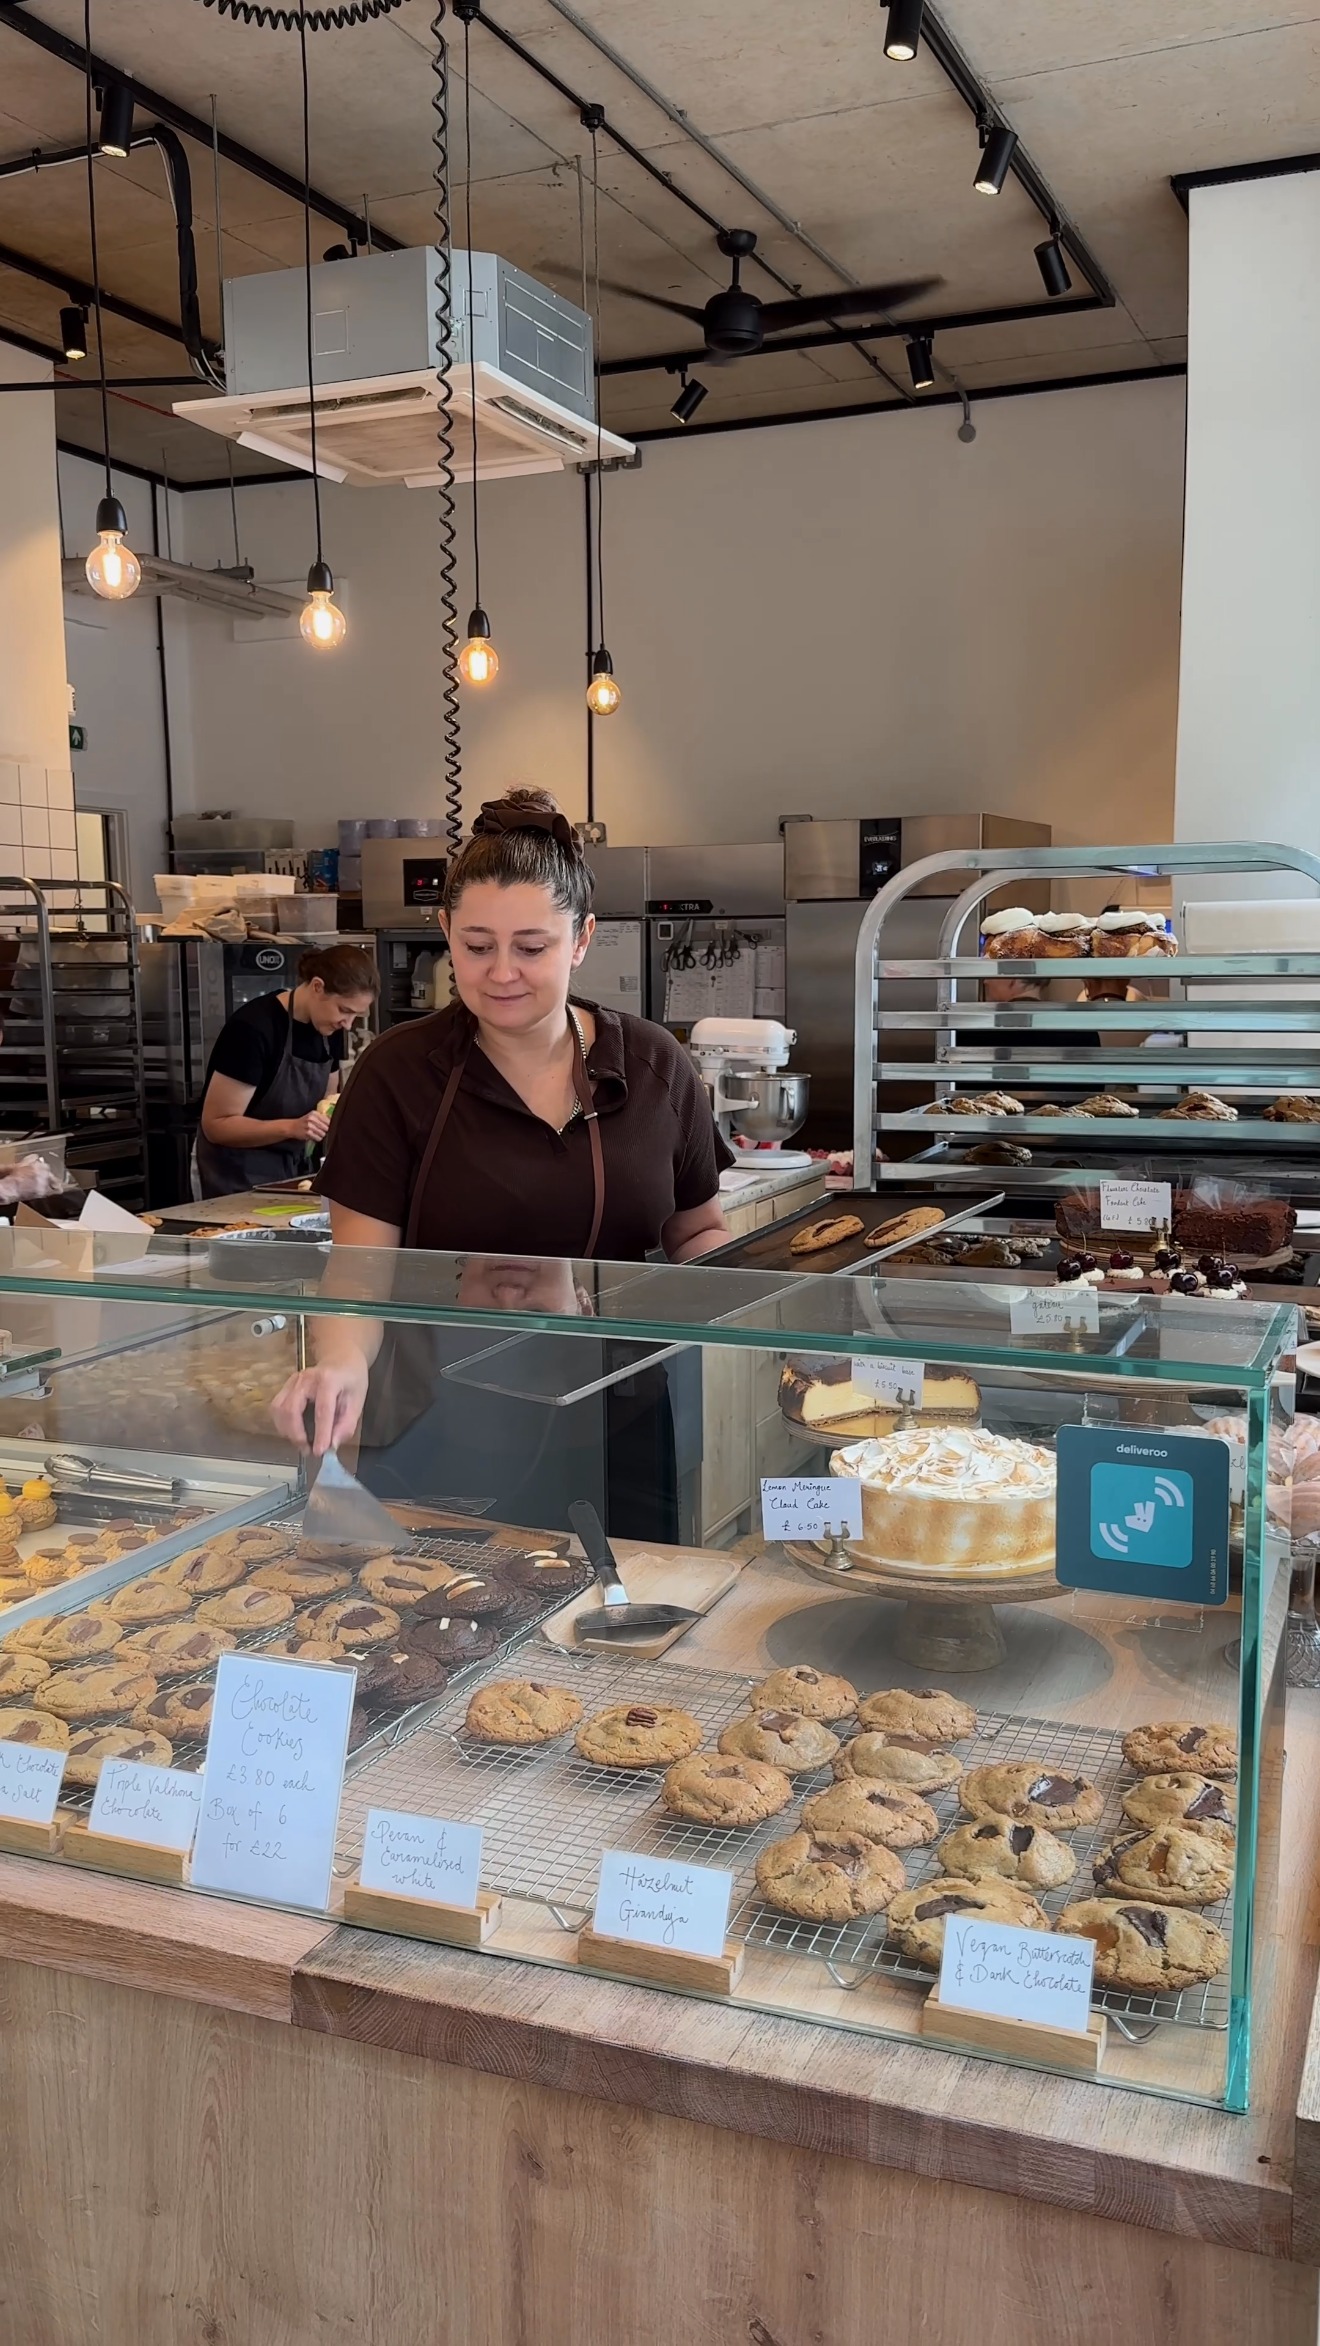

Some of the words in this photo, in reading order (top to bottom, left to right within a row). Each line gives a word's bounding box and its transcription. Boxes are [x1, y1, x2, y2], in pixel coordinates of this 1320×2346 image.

[1116, 1444, 1168, 1458] deliveroo
[762, 1479, 787, 1492] Lemon
[791, 1481, 832, 1496] Meringue
[768, 1497, 799, 1510] Cloud
[806, 1497, 830, 1510] Cake
[231, 1674, 318, 1724] Chocolate
[241, 1721, 304, 1761] Cookies
[16, 1753, 60, 1777] Chocolate
[11, 1784, 43, 1803] Salt
[106, 1763, 142, 1804] Triple
[282, 1770, 315, 1792] each
[100, 1795, 163, 1822] Chocolate
[207, 1797, 240, 1826] Box
[248, 1801, 263, 1831] of
[278, 1804, 287, 1825] 6
[370, 1820, 425, 1844] Pecan
[221, 1832, 242, 1859] for
[249, 1839, 287, 1860] £22
[618, 1866, 694, 1895] Hazelnut
[956, 1925, 1012, 1962] Vegan
[1016, 1941, 1091, 1968] Butterscotch
[969, 1963, 1020, 1985] Dark
[1023, 1970, 1086, 1994] Chocolate
